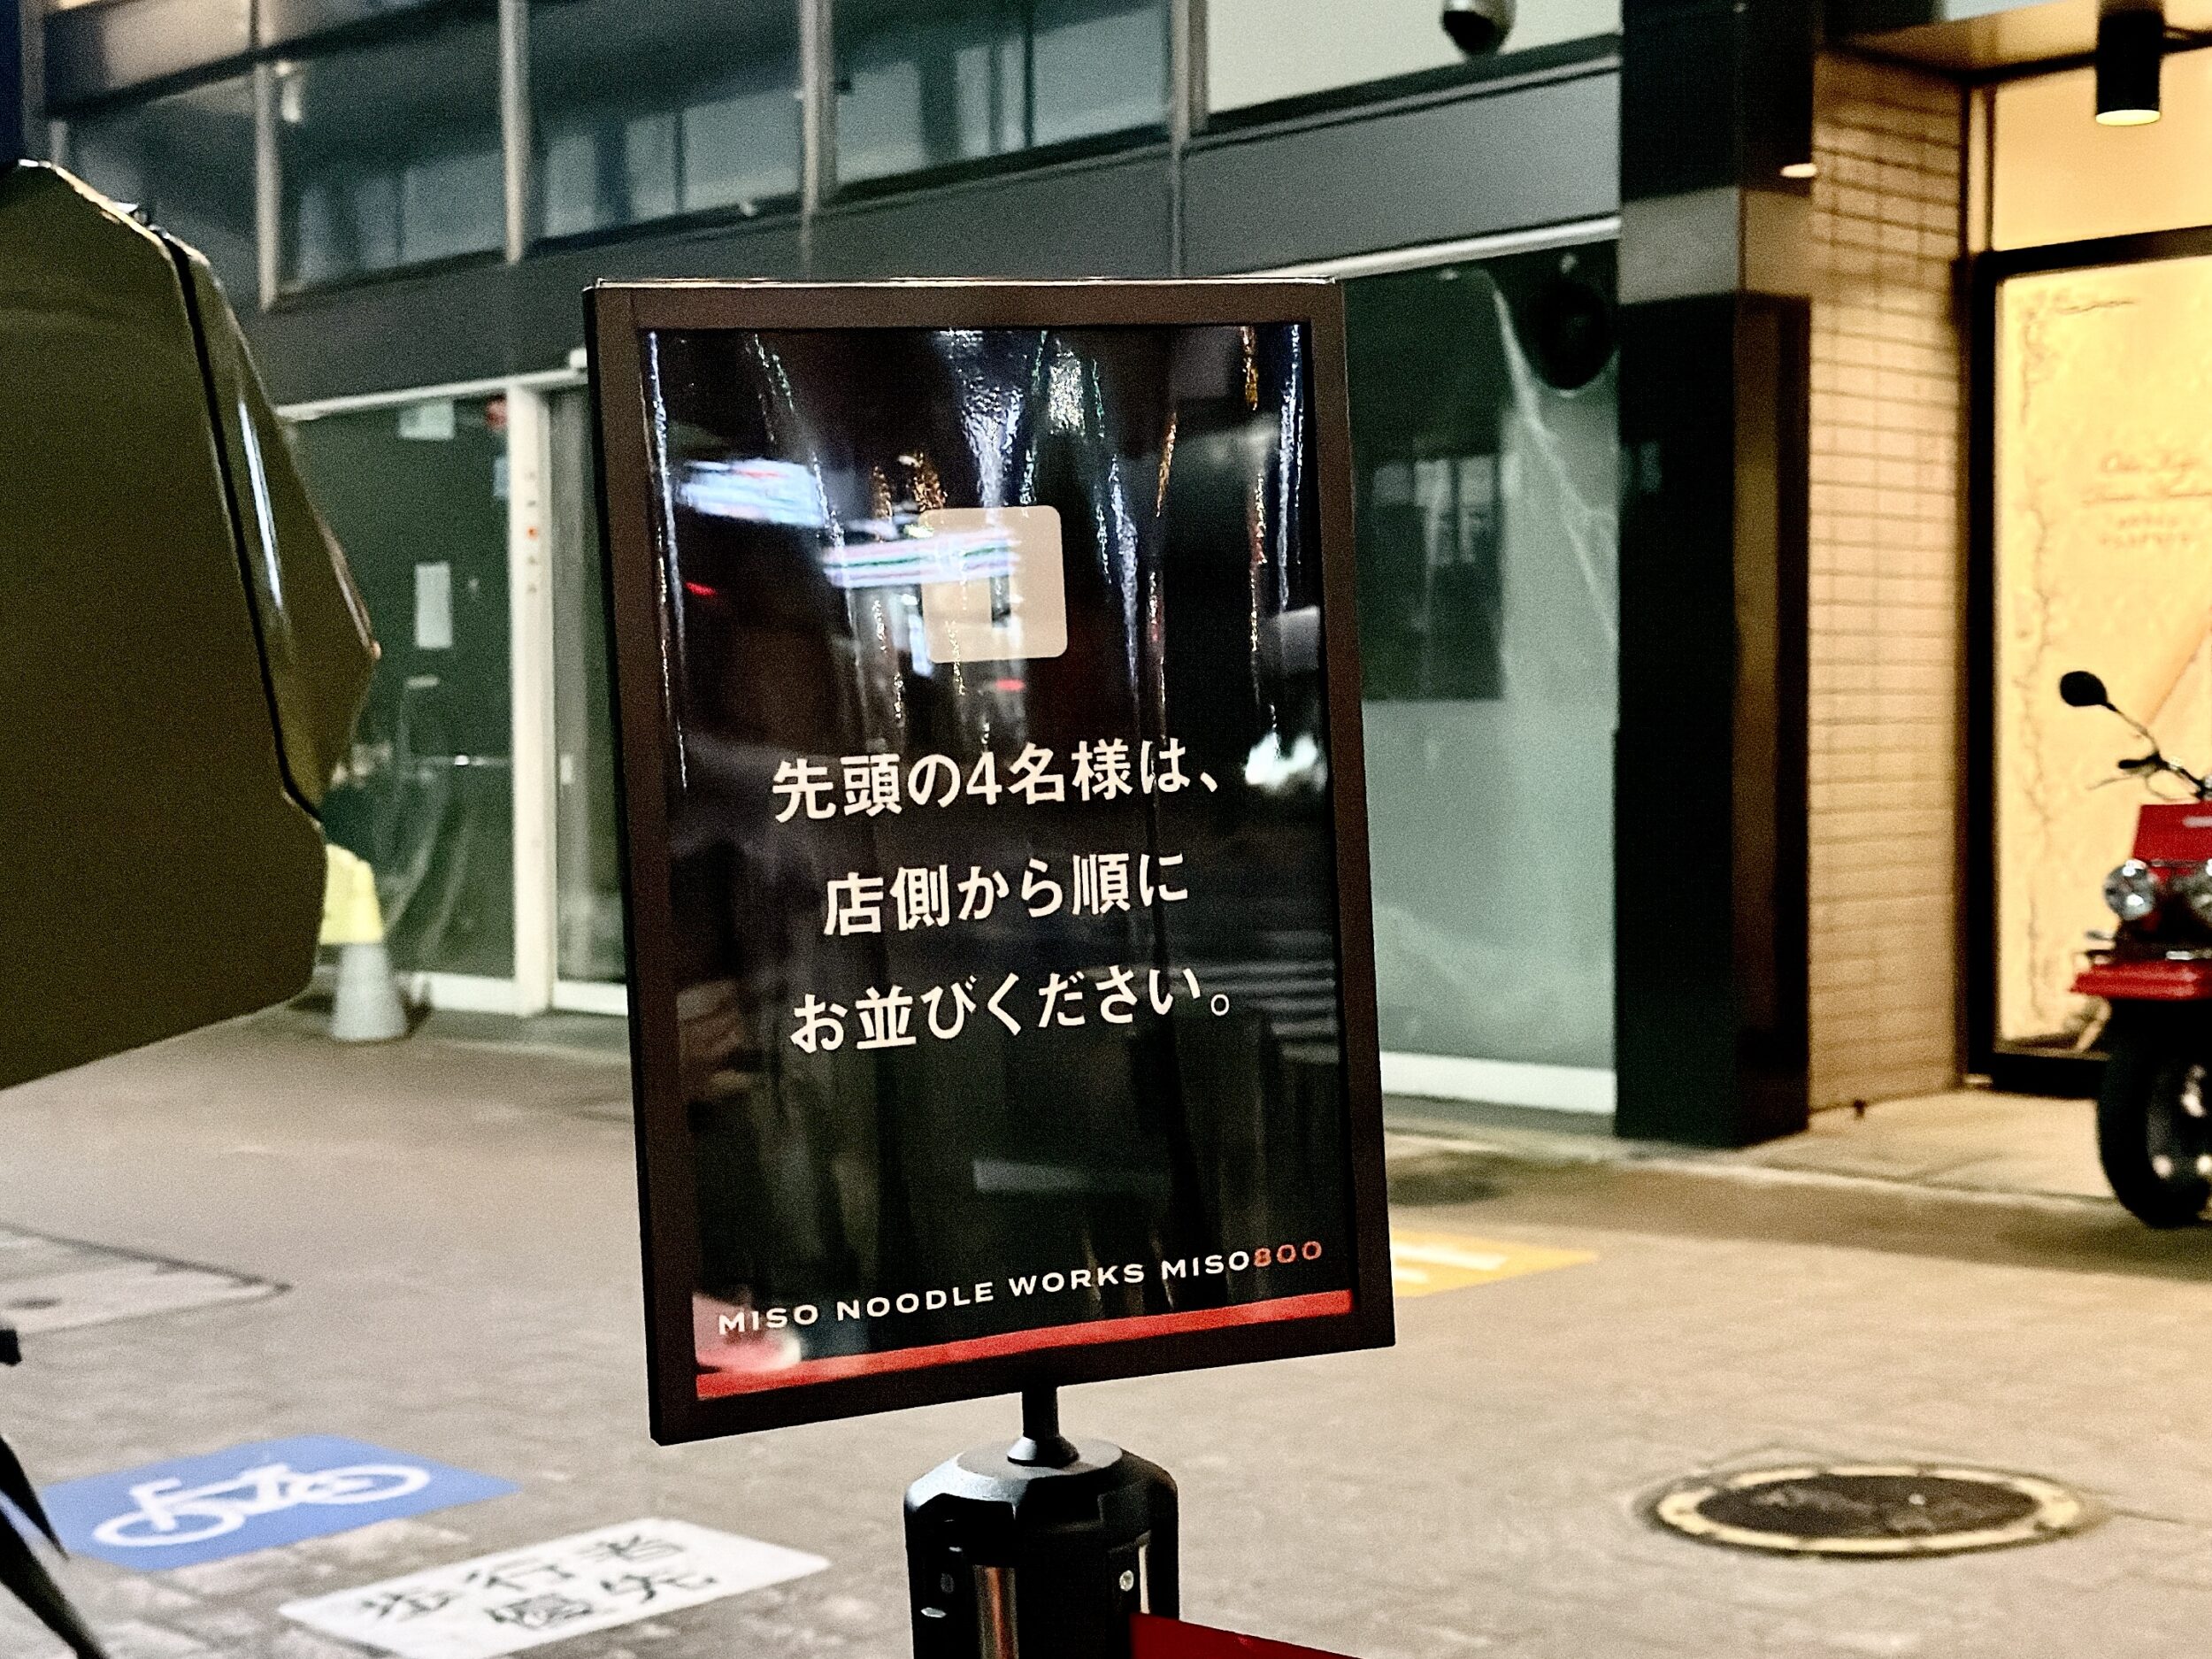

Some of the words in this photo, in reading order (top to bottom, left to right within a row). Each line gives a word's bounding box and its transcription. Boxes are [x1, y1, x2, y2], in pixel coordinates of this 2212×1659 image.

[772, 736, 1219, 823] 先頭の4名様は、
[823, 852, 1189, 937] 店側から順に
[789, 964, 1232, 1055] お並びください。
[718, 1304, 818, 1335] MISO
[836, 1281, 995, 1321] NOODLE
[1008, 1263, 1145, 1298] WORKS
